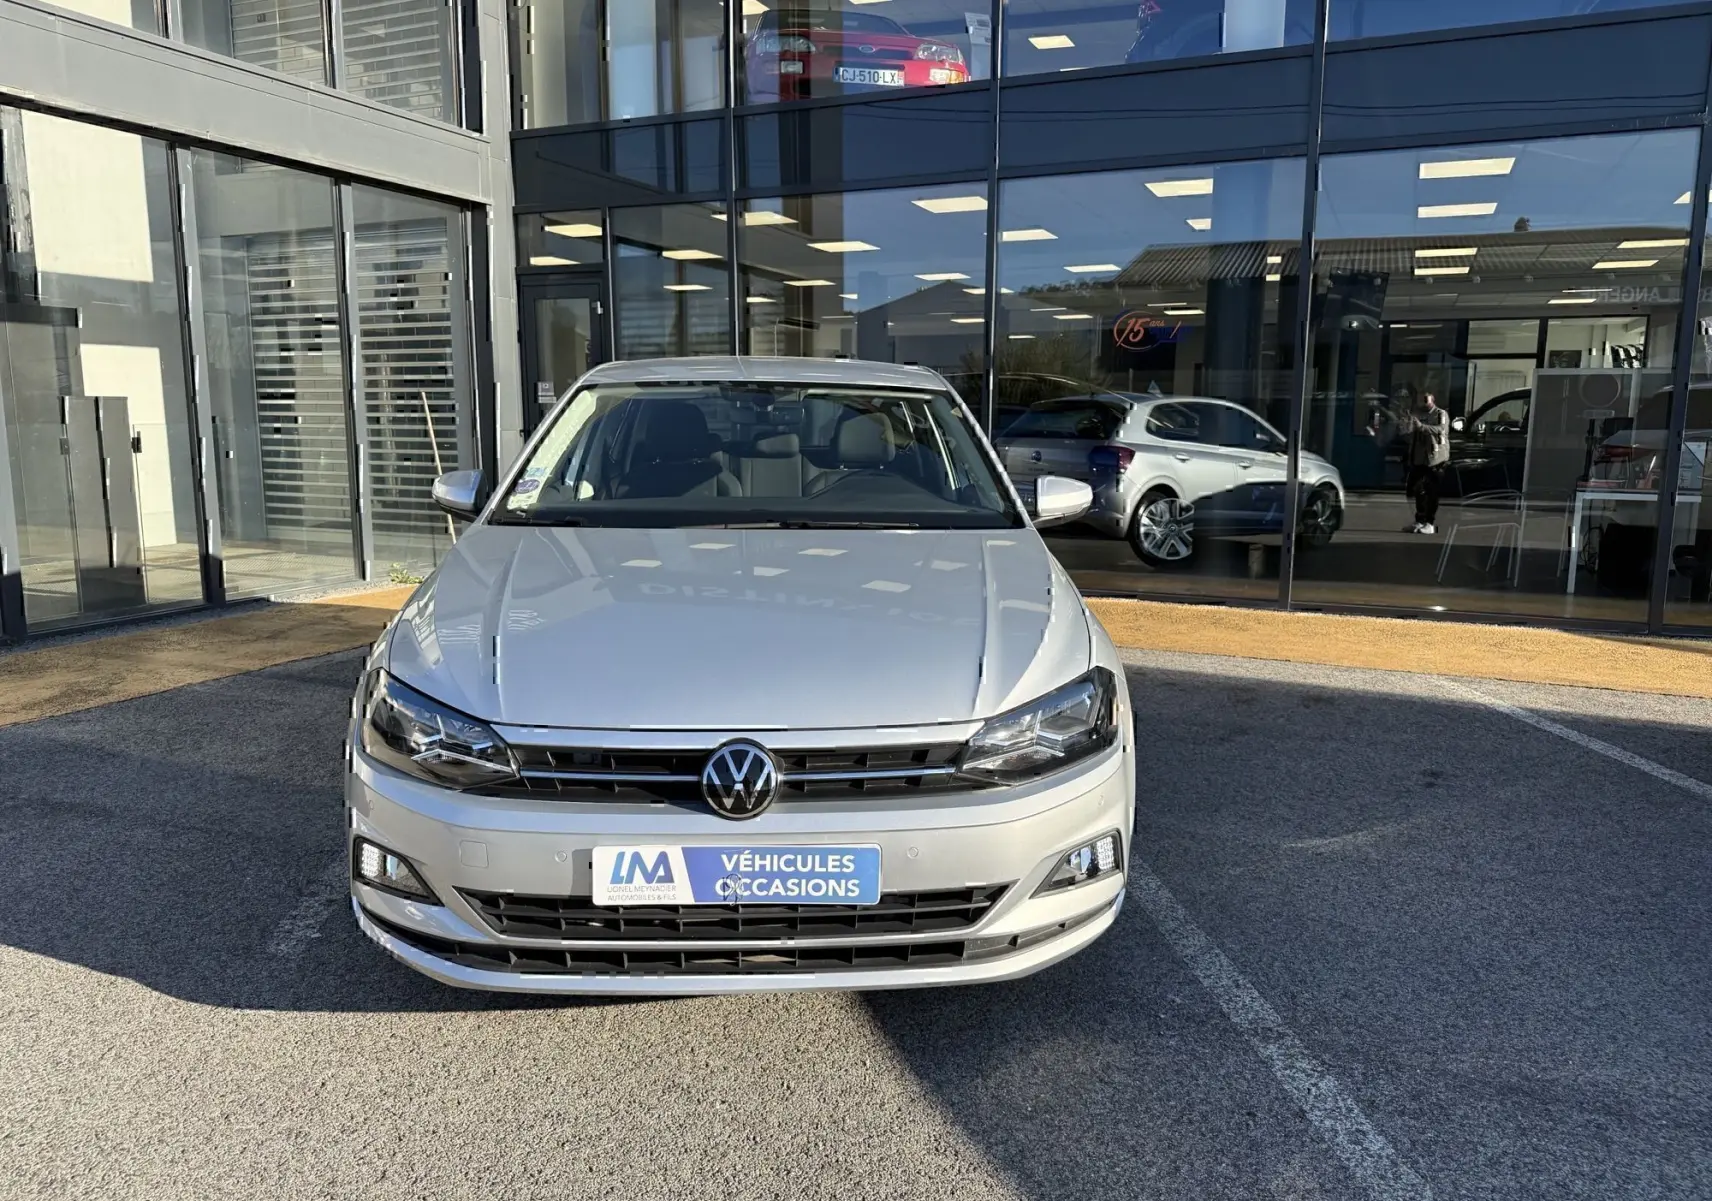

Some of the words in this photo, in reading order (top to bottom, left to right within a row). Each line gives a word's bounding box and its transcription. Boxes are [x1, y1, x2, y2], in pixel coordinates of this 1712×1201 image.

[842, 69, 896, 84] CJ-510-LX
[1117, 318, 1151, 345] 15
[721, 850, 856, 873] VÉHICULES
[607, 885, 633, 893] LIONEL
[634, 885, 677, 893] MEYNADIER
[715, 878, 860, 897] OCCASIONS
[607, 894, 655, 902] AUTOMOBILES
[663, 893, 677, 901] FILS
